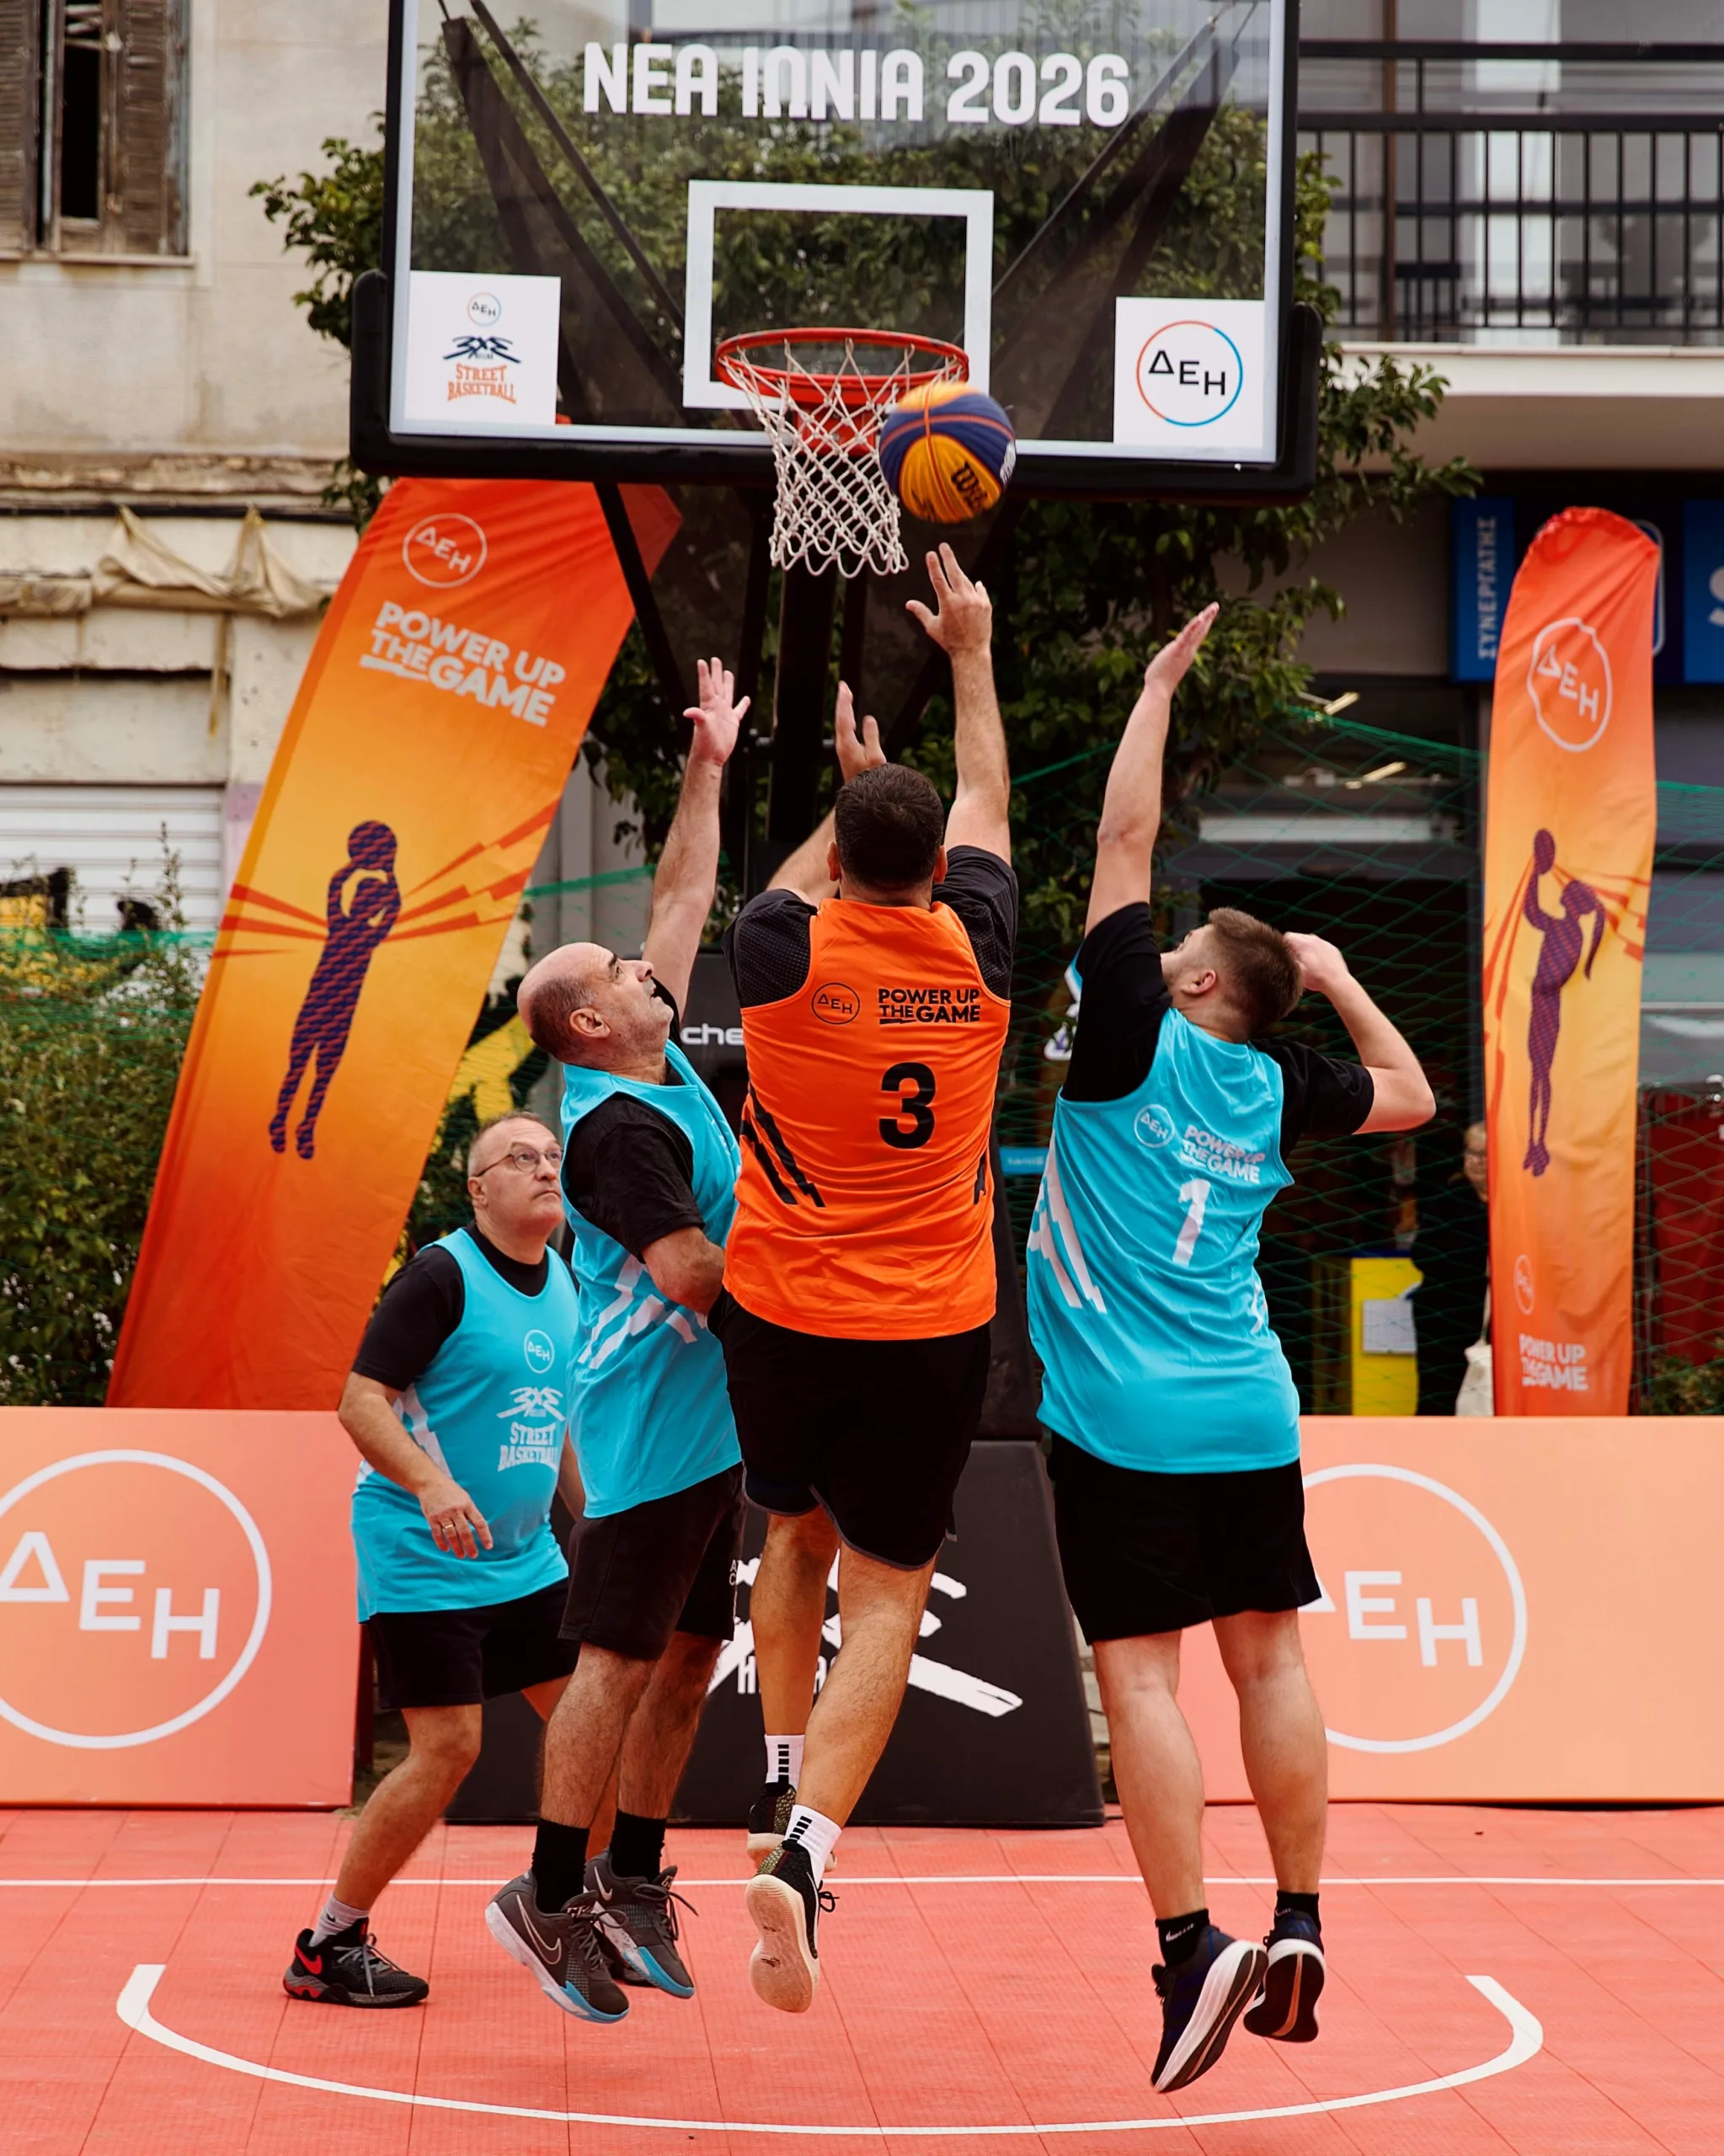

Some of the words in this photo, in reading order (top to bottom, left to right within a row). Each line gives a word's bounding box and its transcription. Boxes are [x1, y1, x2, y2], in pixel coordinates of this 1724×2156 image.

[584, 42, 719, 116] ΝΕΑ
[742, 45, 924, 121] ΙΩΝΙΑ
[947, 51, 1129, 128] 2026
[456, 363, 507, 382] STREET
[1149, 350, 1225, 396] ΔΕΗ
[447, 382, 516, 404] BASKETBALL
[415, 526, 472, 574] ΔΕΗ
[375, 600, 510, 673] POWER
[513, 650, 566, 689] UP
[371, 628, 434, 672] THE
[428, 655, 556, 728] GAME
[1536, 643, 1599, 723] ΔΕΗ
[817, 993, 853, 1014] ΔΕΗ
[878, 989, 952, 1004] POWER
[956, 988, 980, 1003] UP
[879, 1005, 914, 1018] THE
[915, 1005, 980, 1023] GAME
[878, 1062, 936, 1149] 3
[1140, 1113, 1168, 1140] ΔΕΗ
[1184, 1124, 1246, 1159] POWER
[1182, 1139, 1209, 1162] THE
[1207, 1153, 1261, 1184] GAME
[1172, 1178, 1211, 1267] 1
[527, 1341, 550, 1360] ΔΕΗ
[1557, 1343, 1586, 1364] UP
[510, 1422, 556, 1445] STREET
[497, 1444, 559, 1472] BASKETBALL
[0, 1531, 221, 1659] ΔΕΗ
[1298, 1572, 1483, 1666] ΕΗ
